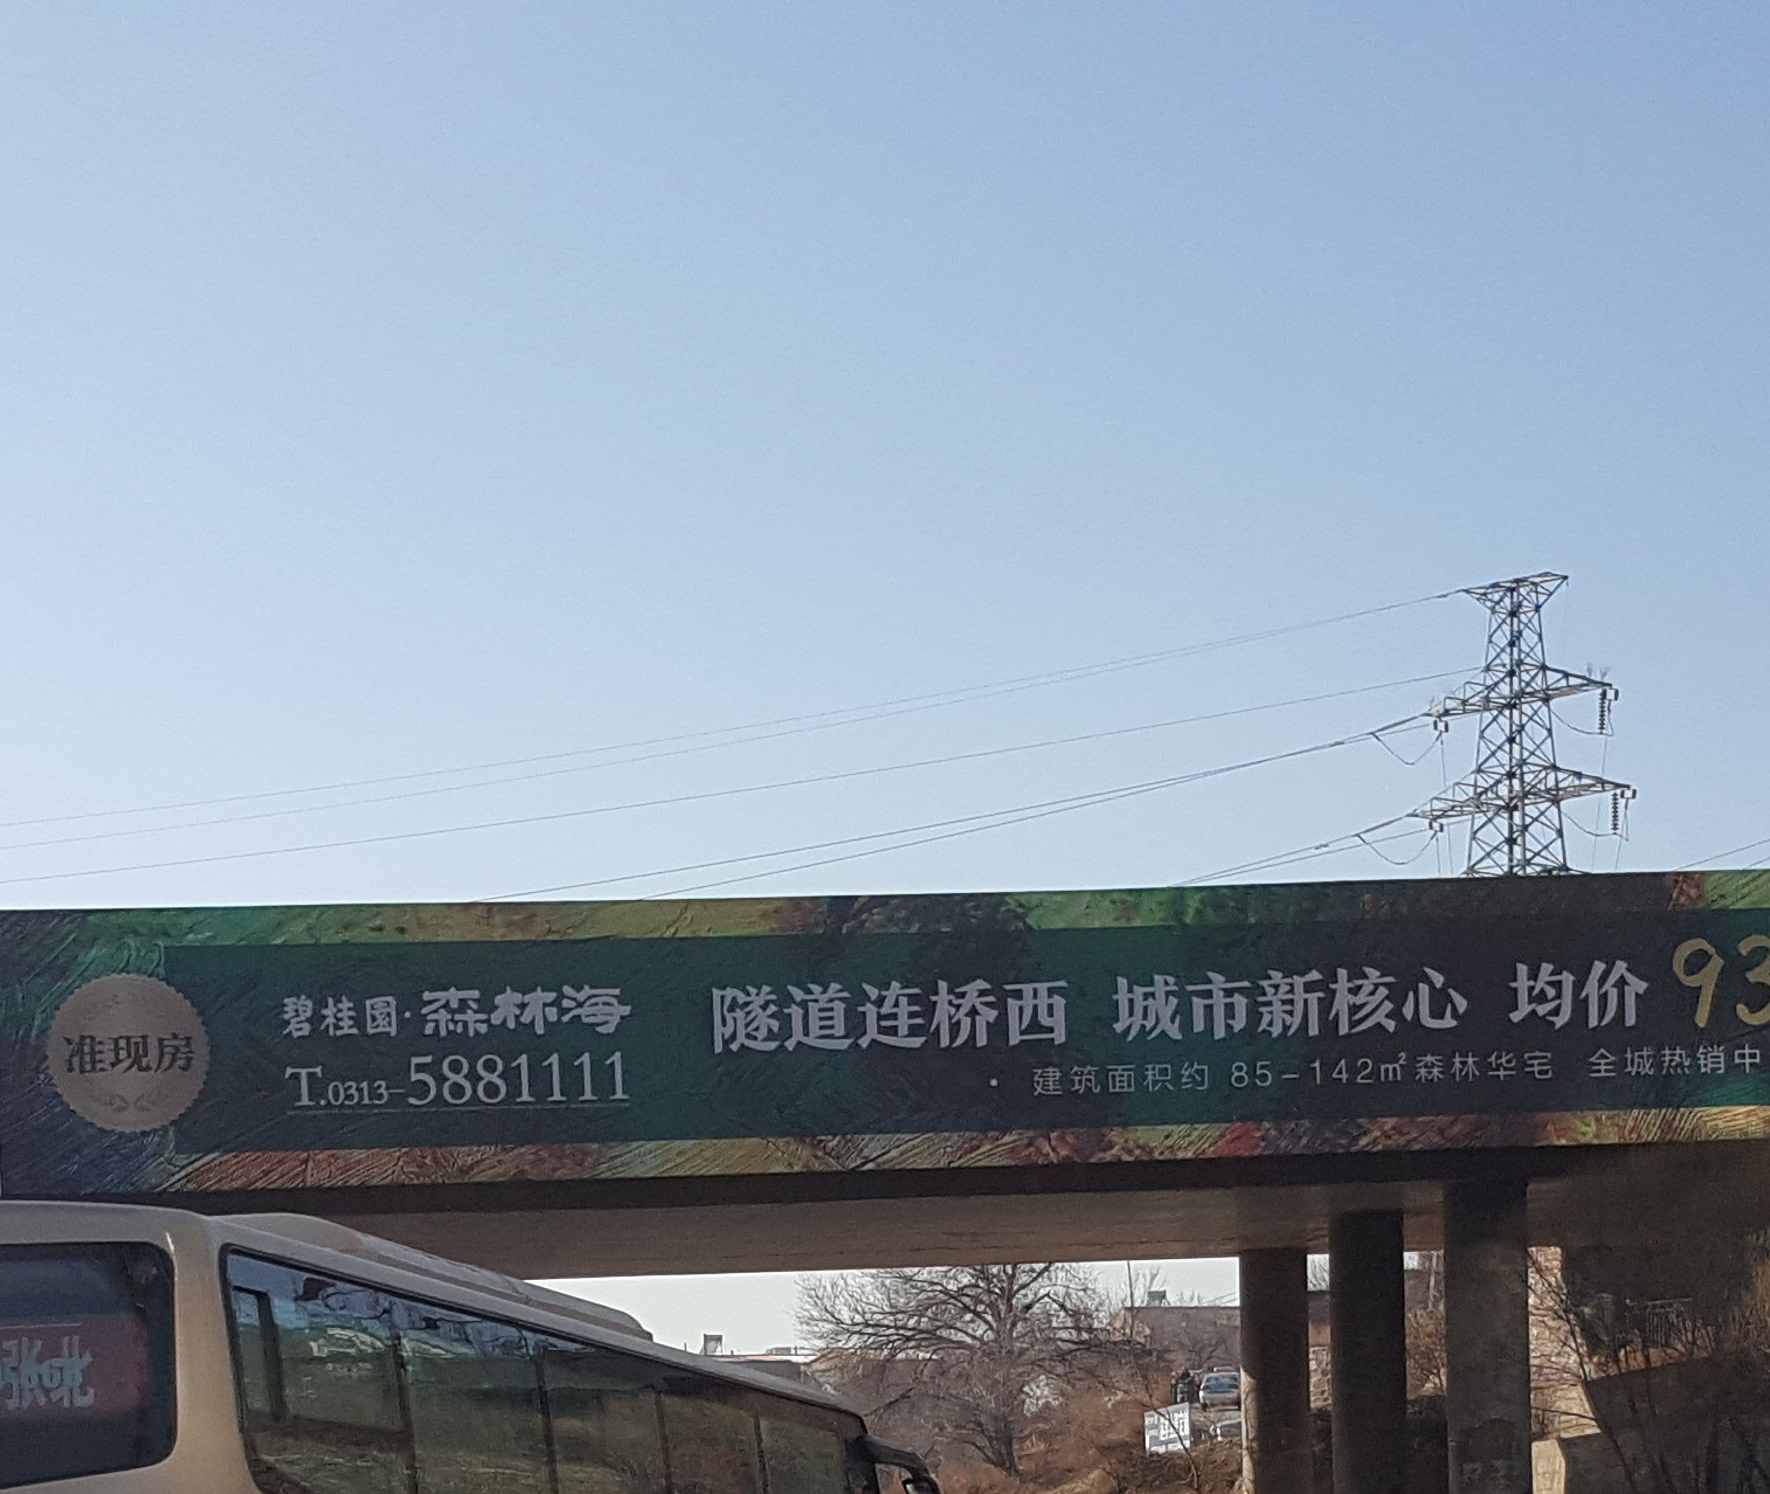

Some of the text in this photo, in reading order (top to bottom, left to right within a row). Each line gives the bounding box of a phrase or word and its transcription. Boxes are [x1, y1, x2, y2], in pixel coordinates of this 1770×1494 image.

[710, 977, 1069, 1055] 隧道连桥西
[1111, 965, 1469, 1042] 城市新核心
[1507, 958, 1649, 1030] 均价
[63, 1032, 195, 1075] 准现房
[1031, 1061, 1210, 1097] 建筑面积约
[1588, 1042, 1762, 1079] 全城热销中
